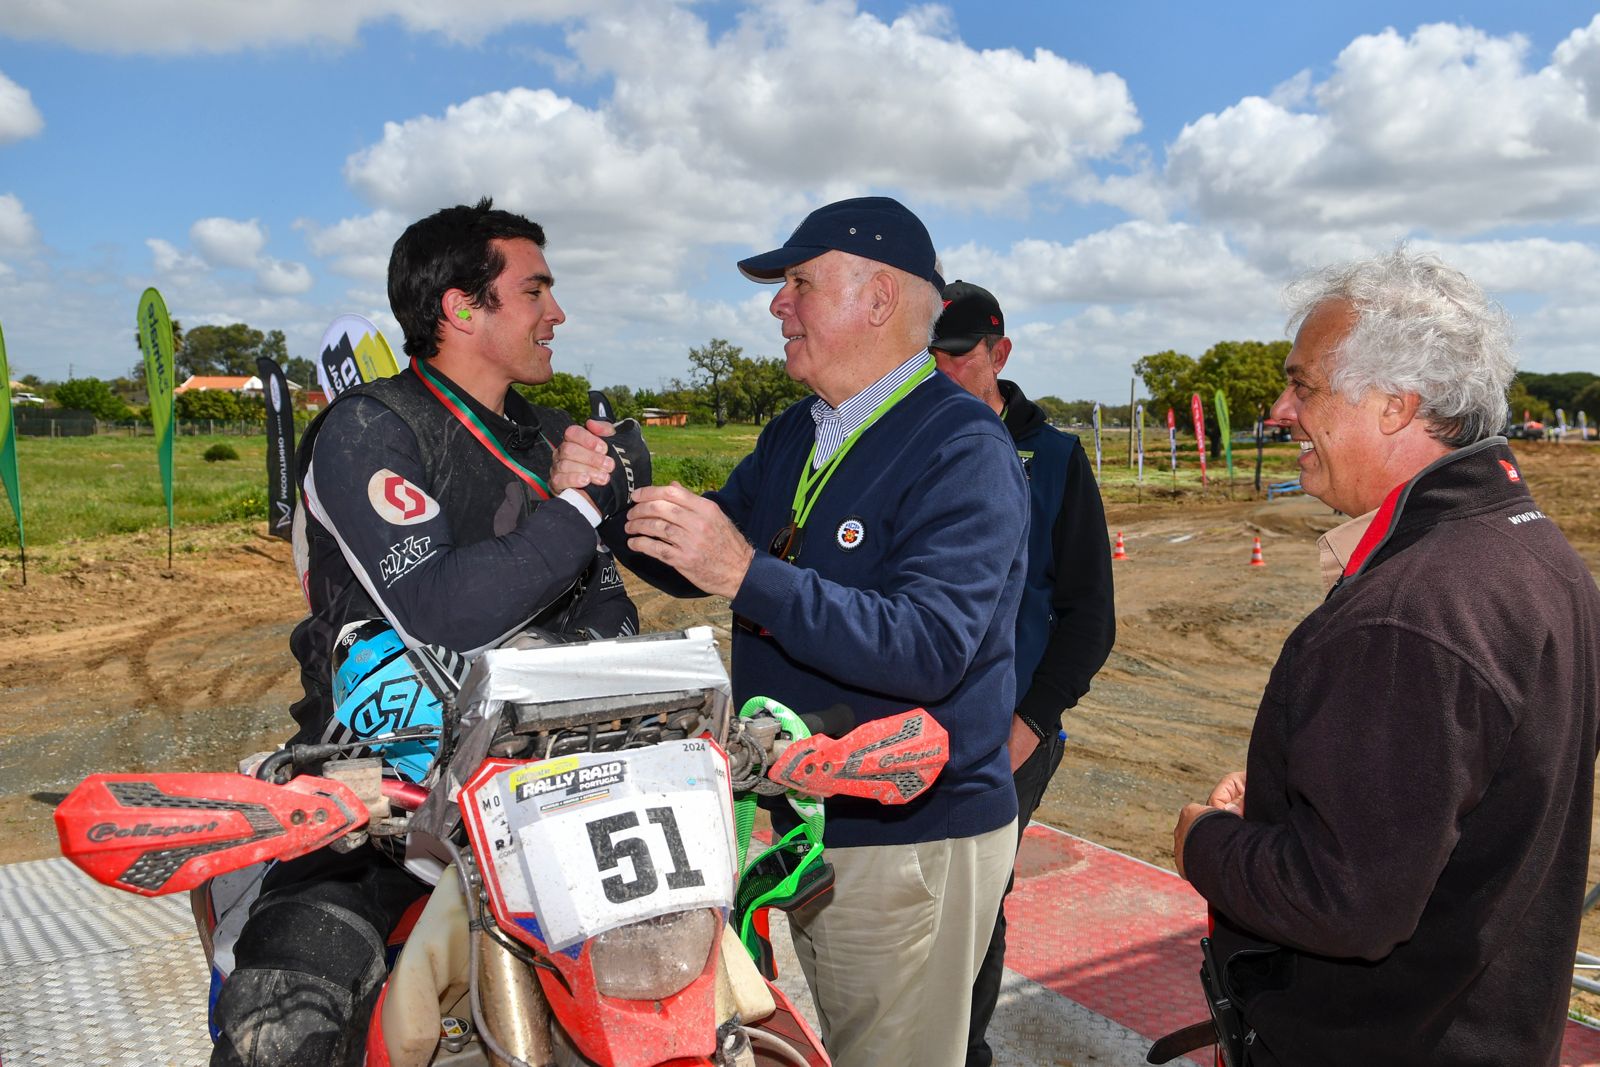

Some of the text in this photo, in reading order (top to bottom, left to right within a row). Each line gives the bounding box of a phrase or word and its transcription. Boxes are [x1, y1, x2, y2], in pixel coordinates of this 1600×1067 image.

[380, 536, 431, 581] MXT
[682, 743, 706, 752] 2024
[523, 771, 576, 799] RALLY
[578, 762, 622, 783] RAID
[580, 776, 620, 791] PORTUGAL
[87, 821, 219, 843] Polisport
[585, 806, 705, 904] 51
